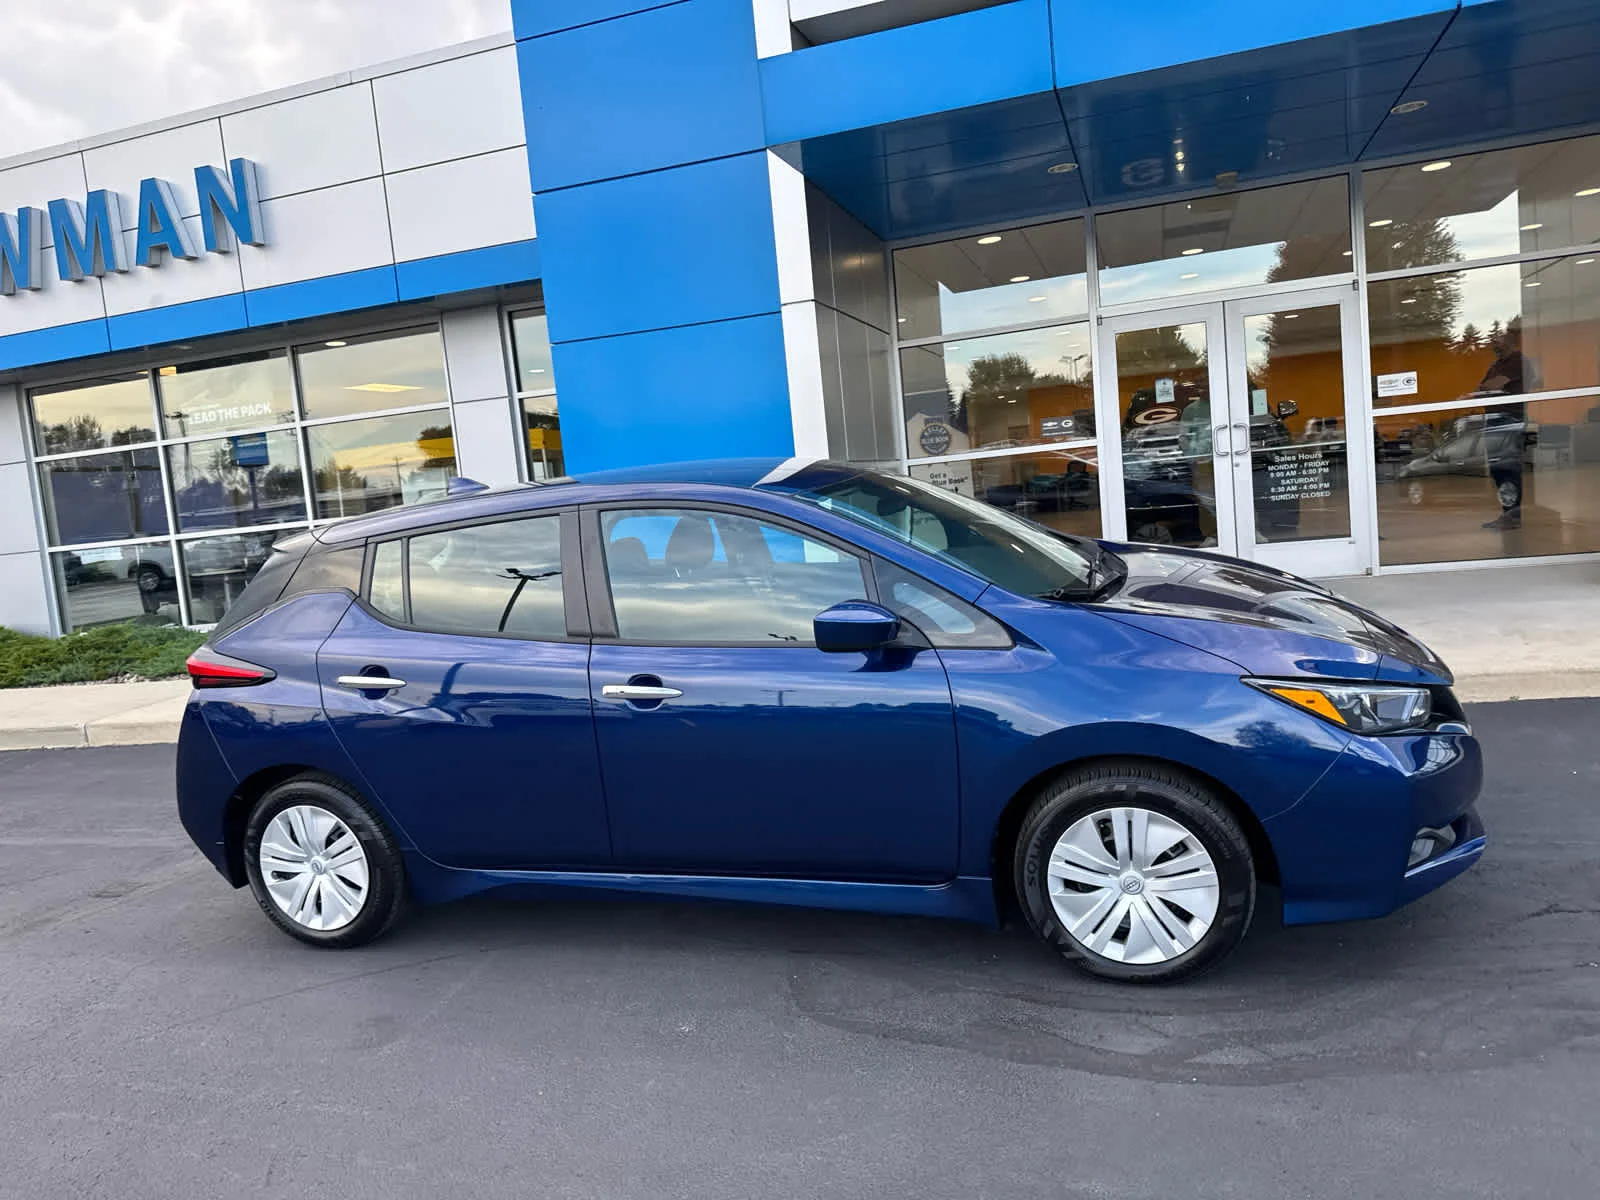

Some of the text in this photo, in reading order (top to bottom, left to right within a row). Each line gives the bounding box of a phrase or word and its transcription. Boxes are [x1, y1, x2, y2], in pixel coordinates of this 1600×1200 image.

[187, 410, 217, 425] LEAD
[216, 406, 239, 420] THE
[240, 402, 272, 417] PACK
[1274, 452, 1323, 463] Sales Hours
[1268, 463, 1298, 471] MONDAY
[1304, 460, 1330, 468] FRIDAY
[1280, 476, 1318, 485] SATURDAY
[1286, 484, 1298, 492] AM
[1271, 491, 1331, 501] SUNDAY CLOSED
